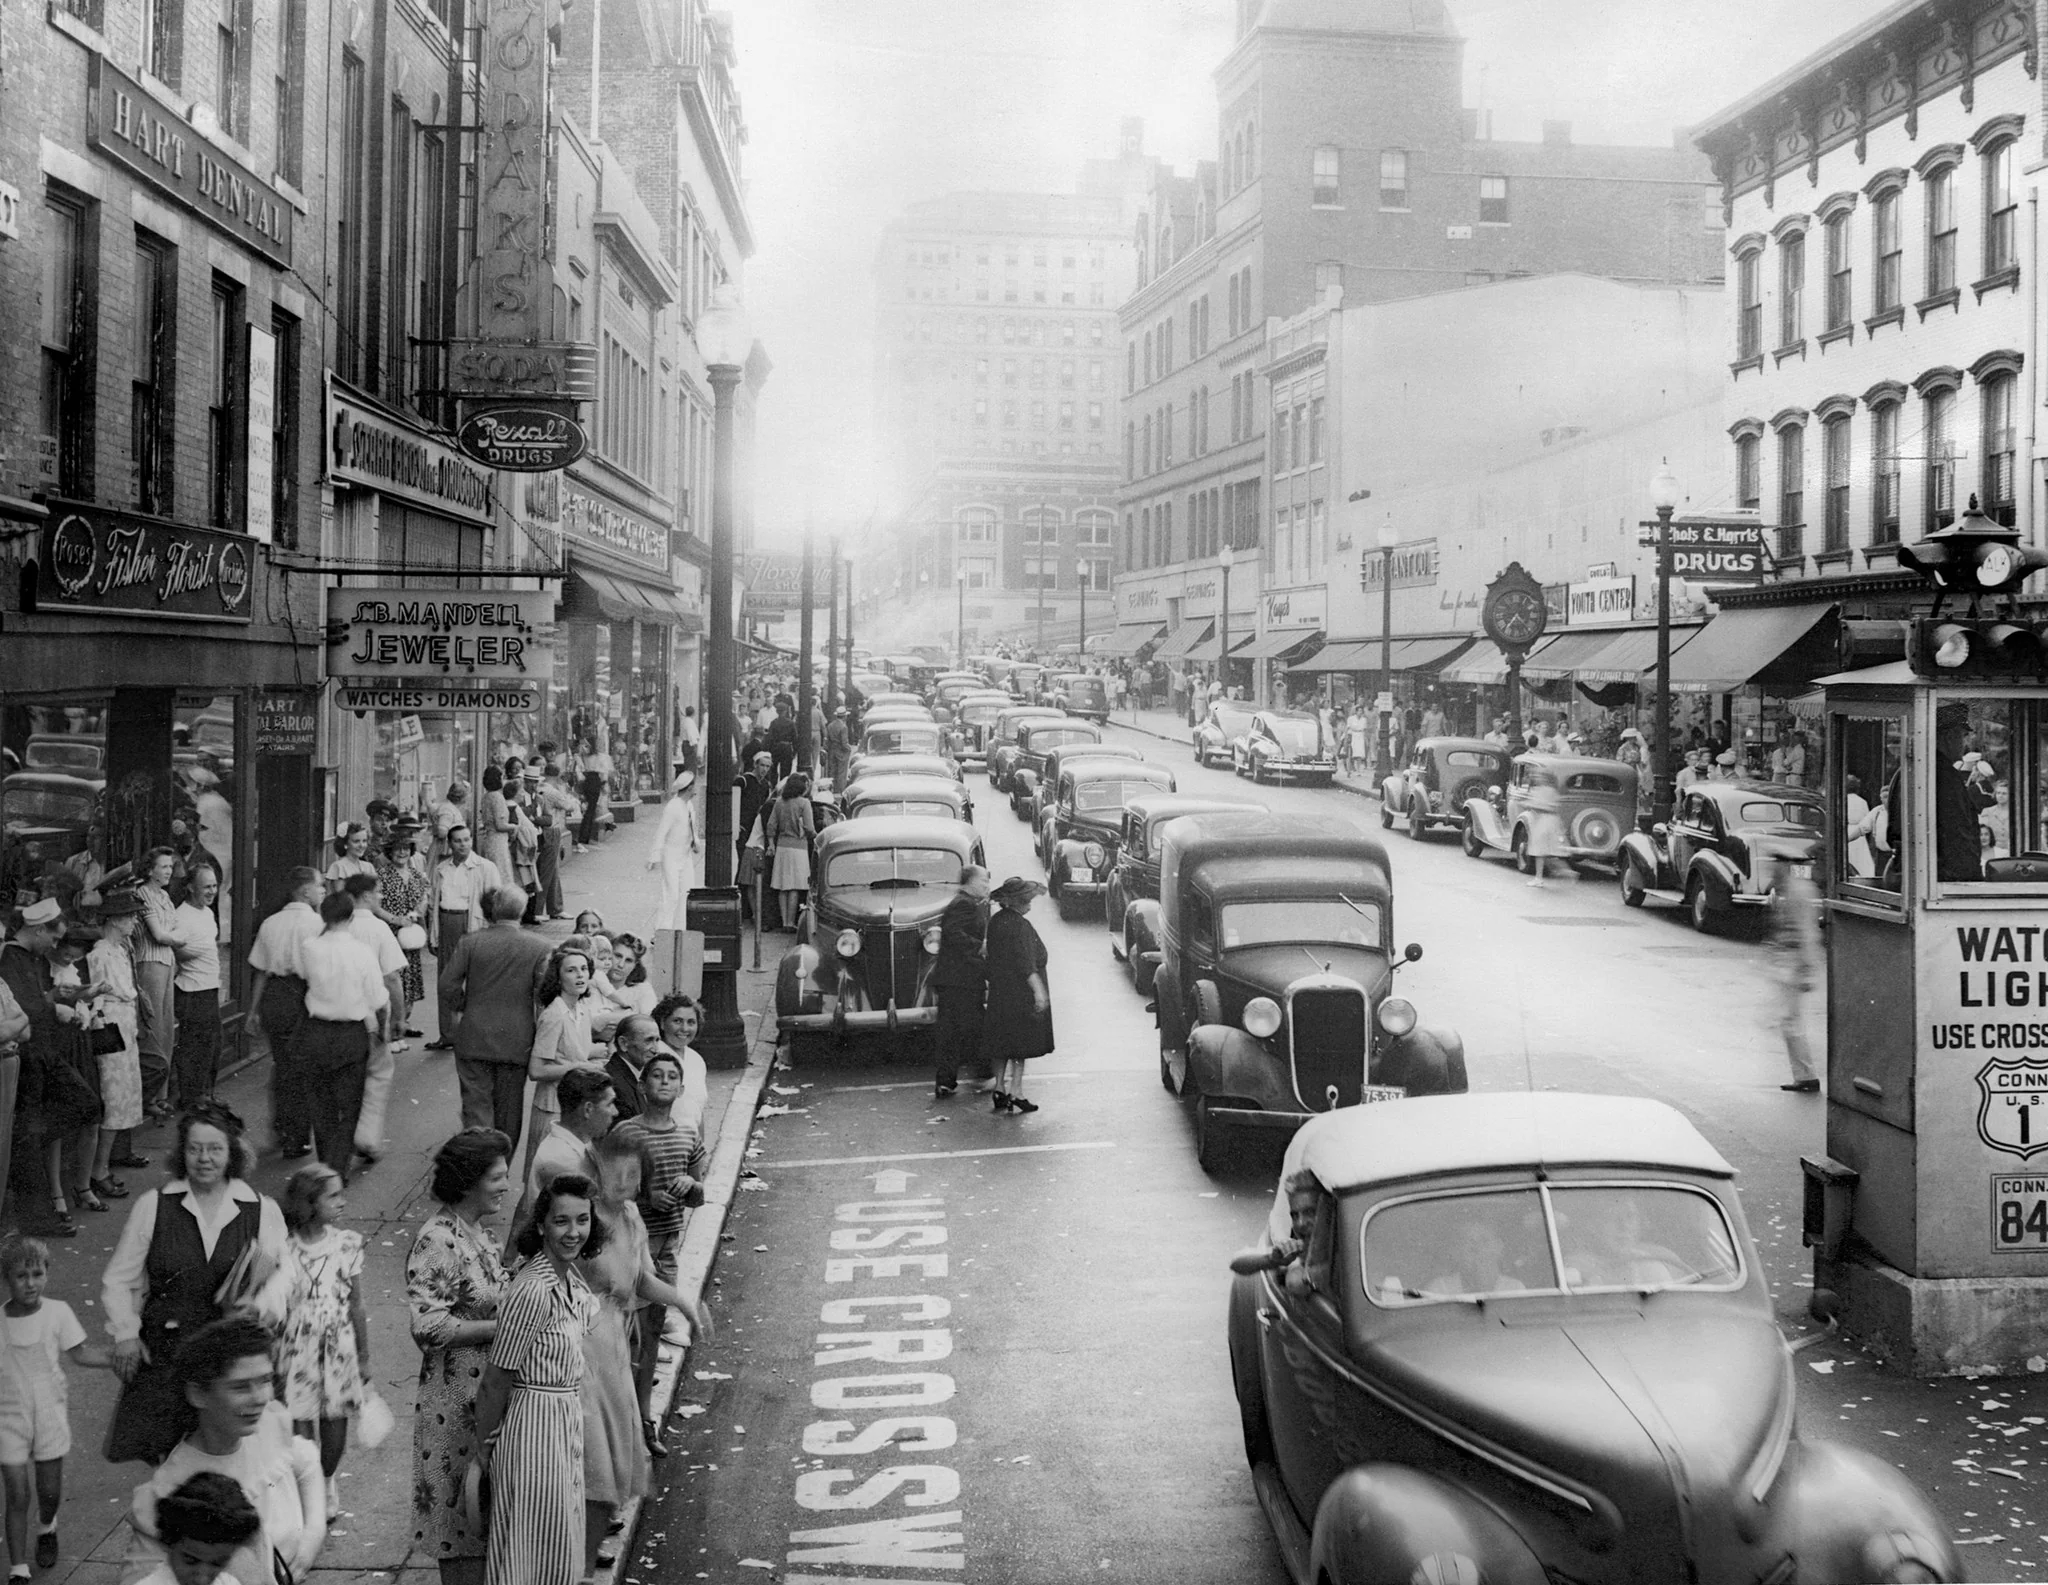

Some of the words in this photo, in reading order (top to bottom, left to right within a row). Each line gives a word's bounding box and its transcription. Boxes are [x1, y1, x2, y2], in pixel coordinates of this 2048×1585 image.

[113, 89, 184, 179] HART
[198, 151, 284, 246] DENTAL
[475, 417, 568, 448] Rexall
[487, 449, 554, 464] DRUGS
[1717, 526, 1760, 545] Harris
[58, 535, 91, 566] Roses
[97, 526, 159, 595] Fisher
[1673, 550, 1757, 573] DRUGS
[1571, 591, 1596, 616] YOUTH
[1599, 587, 1631, 613] CENTER
[351, 630, 526, 668] JEWELER
[346, 691, 424, 708] WATCHES
[438, 692, 531, 709] DIAMONDS
[274, 715, 315, 731] PARLOR
[1956, 926, 2048, 963] WAT
[1932, 1024, 1976, 1049] USE
[2018, 1104, 2030, 1145] 1
[2001, 1200, 2048, 1243] 84
[825, 1198, 949, 1282] USE
[784, 1294, 967, 1585] CROSSW
